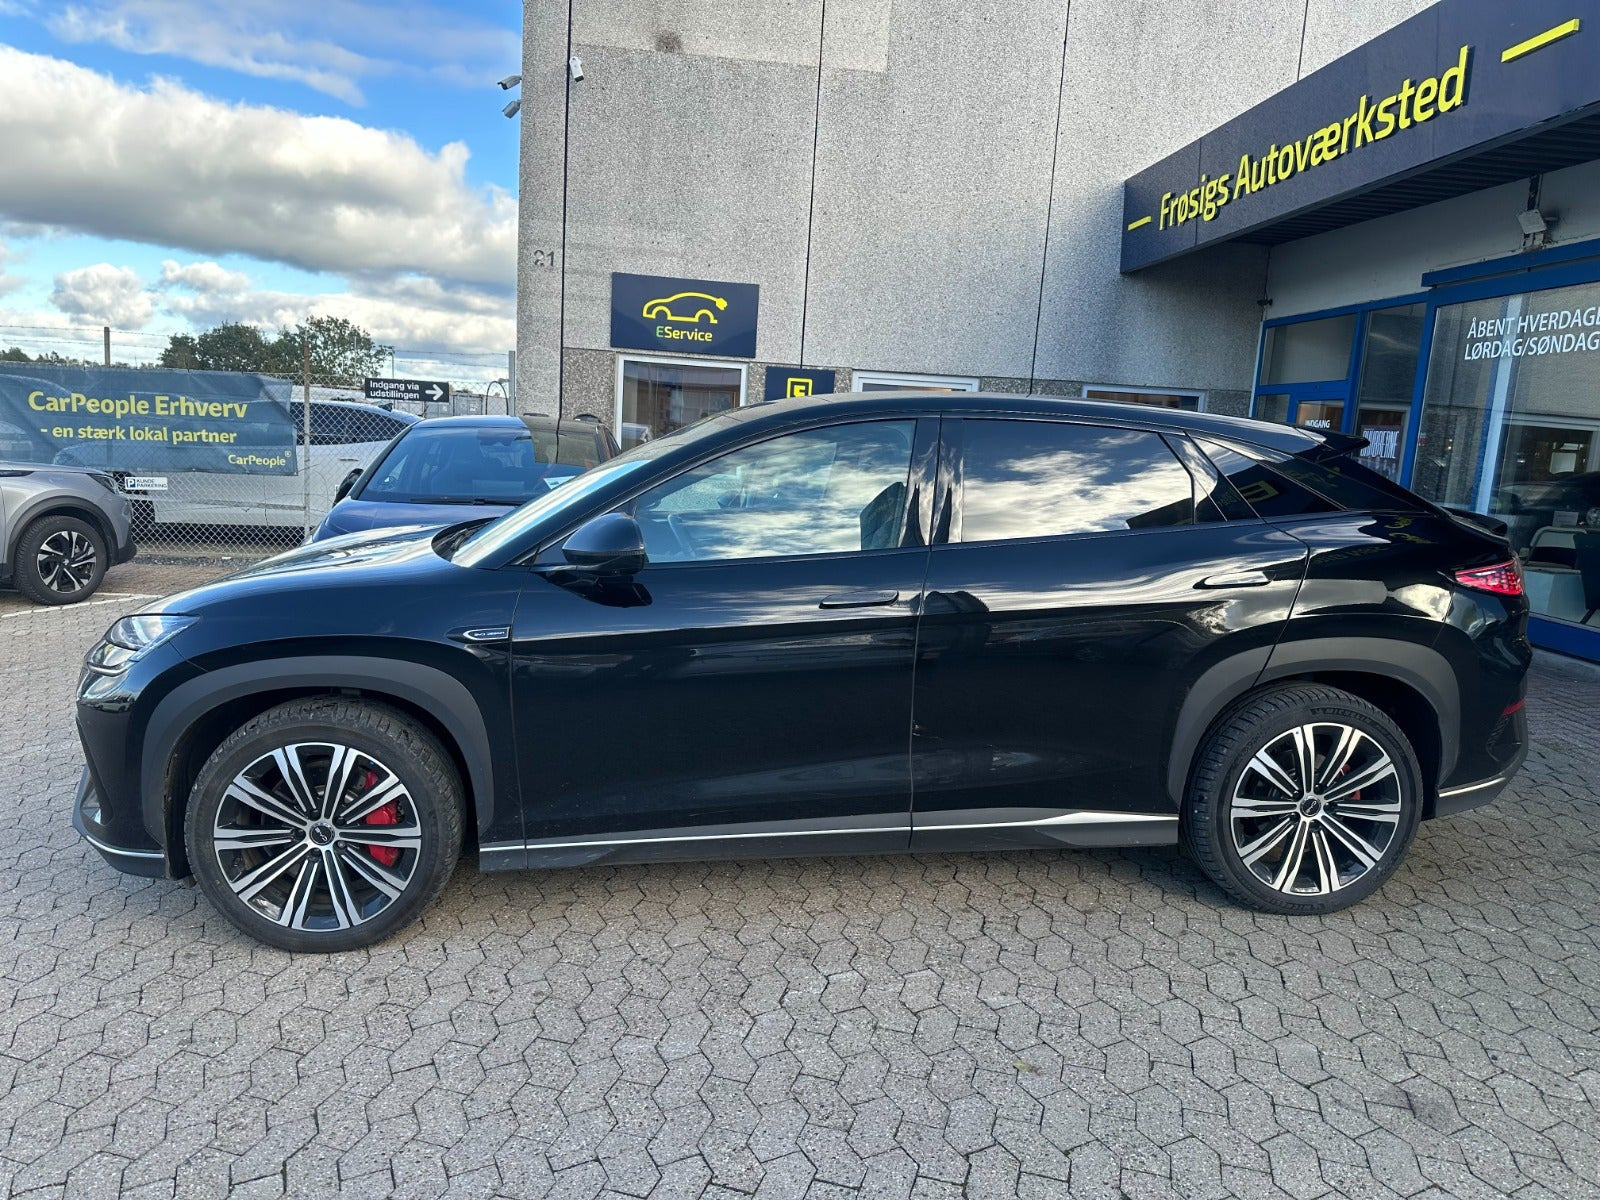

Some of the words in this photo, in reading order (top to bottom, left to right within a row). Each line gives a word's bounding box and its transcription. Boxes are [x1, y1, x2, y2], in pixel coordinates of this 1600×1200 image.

[1159, 174, 1230, 231] Frøsigs
[1233, 45, 1469, 199] Autoværksted
[534, 250, 554, 266] 21
[656, 325, 713, 341] EService
[1467, 317, 1515, 339] ÅBENT
[1464, 331, 1600, 361] LØRDAG/SØNDAG
[370, 380, 405, 390] Indgang
[407, 382, 419, 390] via
[370, 389, 420, 399] udstillingen
[28, 391, 150, 419] CarPeople
[155, 395, 248, 418] Erhverv
[52, 426, 74, 438] en
[78, 425, 126, 440] stærk
[130, 426, 169, 442] lokal
[172, 429, 238, 445] partner
[228, 454, 286, 468] CarPeople
